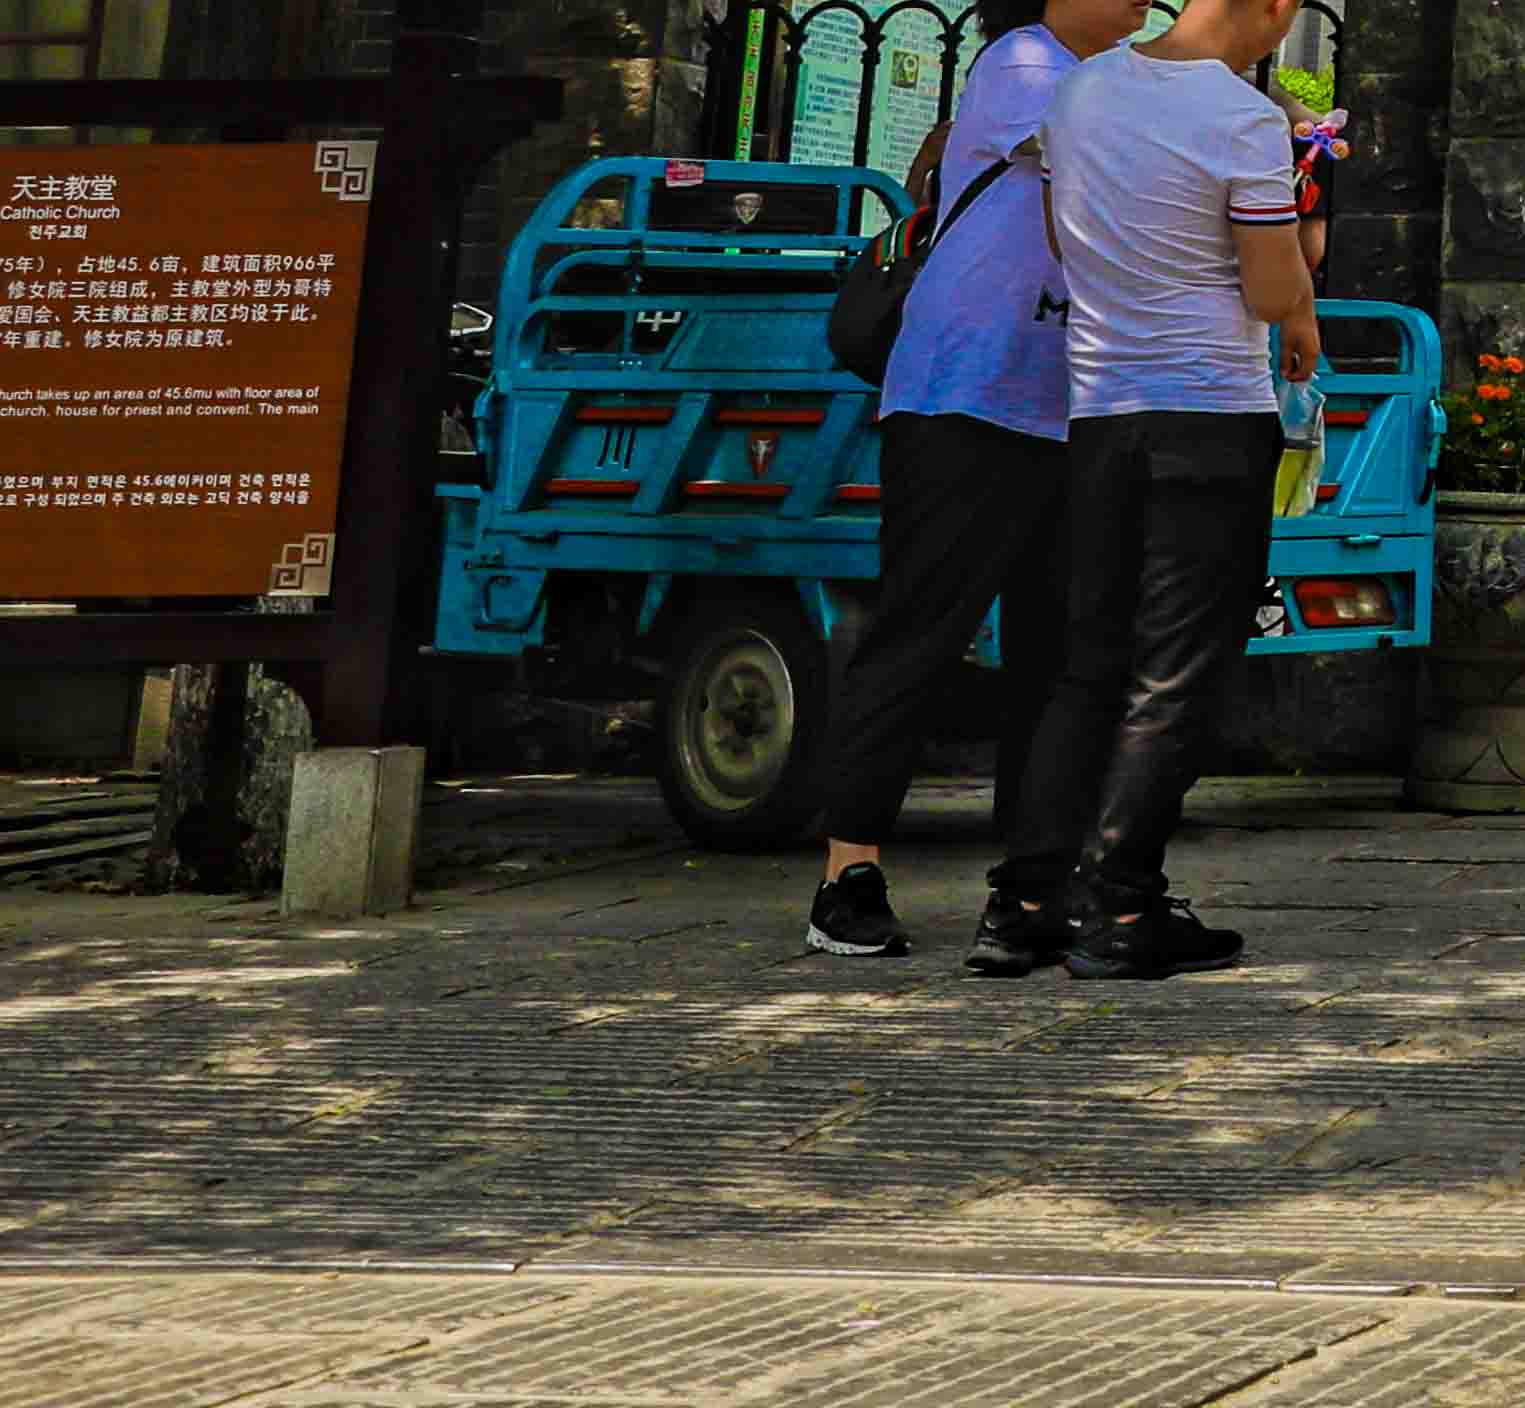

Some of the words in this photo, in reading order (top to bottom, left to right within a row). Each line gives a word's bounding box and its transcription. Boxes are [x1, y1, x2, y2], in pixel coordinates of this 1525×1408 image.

[10, 174, 117, 200] 天主教堂
[0, 205, 62, 220] Catholic
[65, 205, 120, 219] Church
[0, 388, 33, 400] hurch
[36, 388, 70, 399] takes
[74, 390, 91, 401] up
[94, 390, 110, 399] an
[113, 390, 143, 399] area
[148, 387, 161, 399] of
[216, 387, 241, 398] with
[244, 387, 272, 398] floor
[274, 389, 303, 398] area
[306, 386, 320, 398] of
[56, 405, 97, 416] house
[103, 405, 120, 416] for
[125, 405, 162, 418] priest
[166, 404, 192, 415] and
[258, 403, 283, 414] The
[287, 403, 319, 414] main
